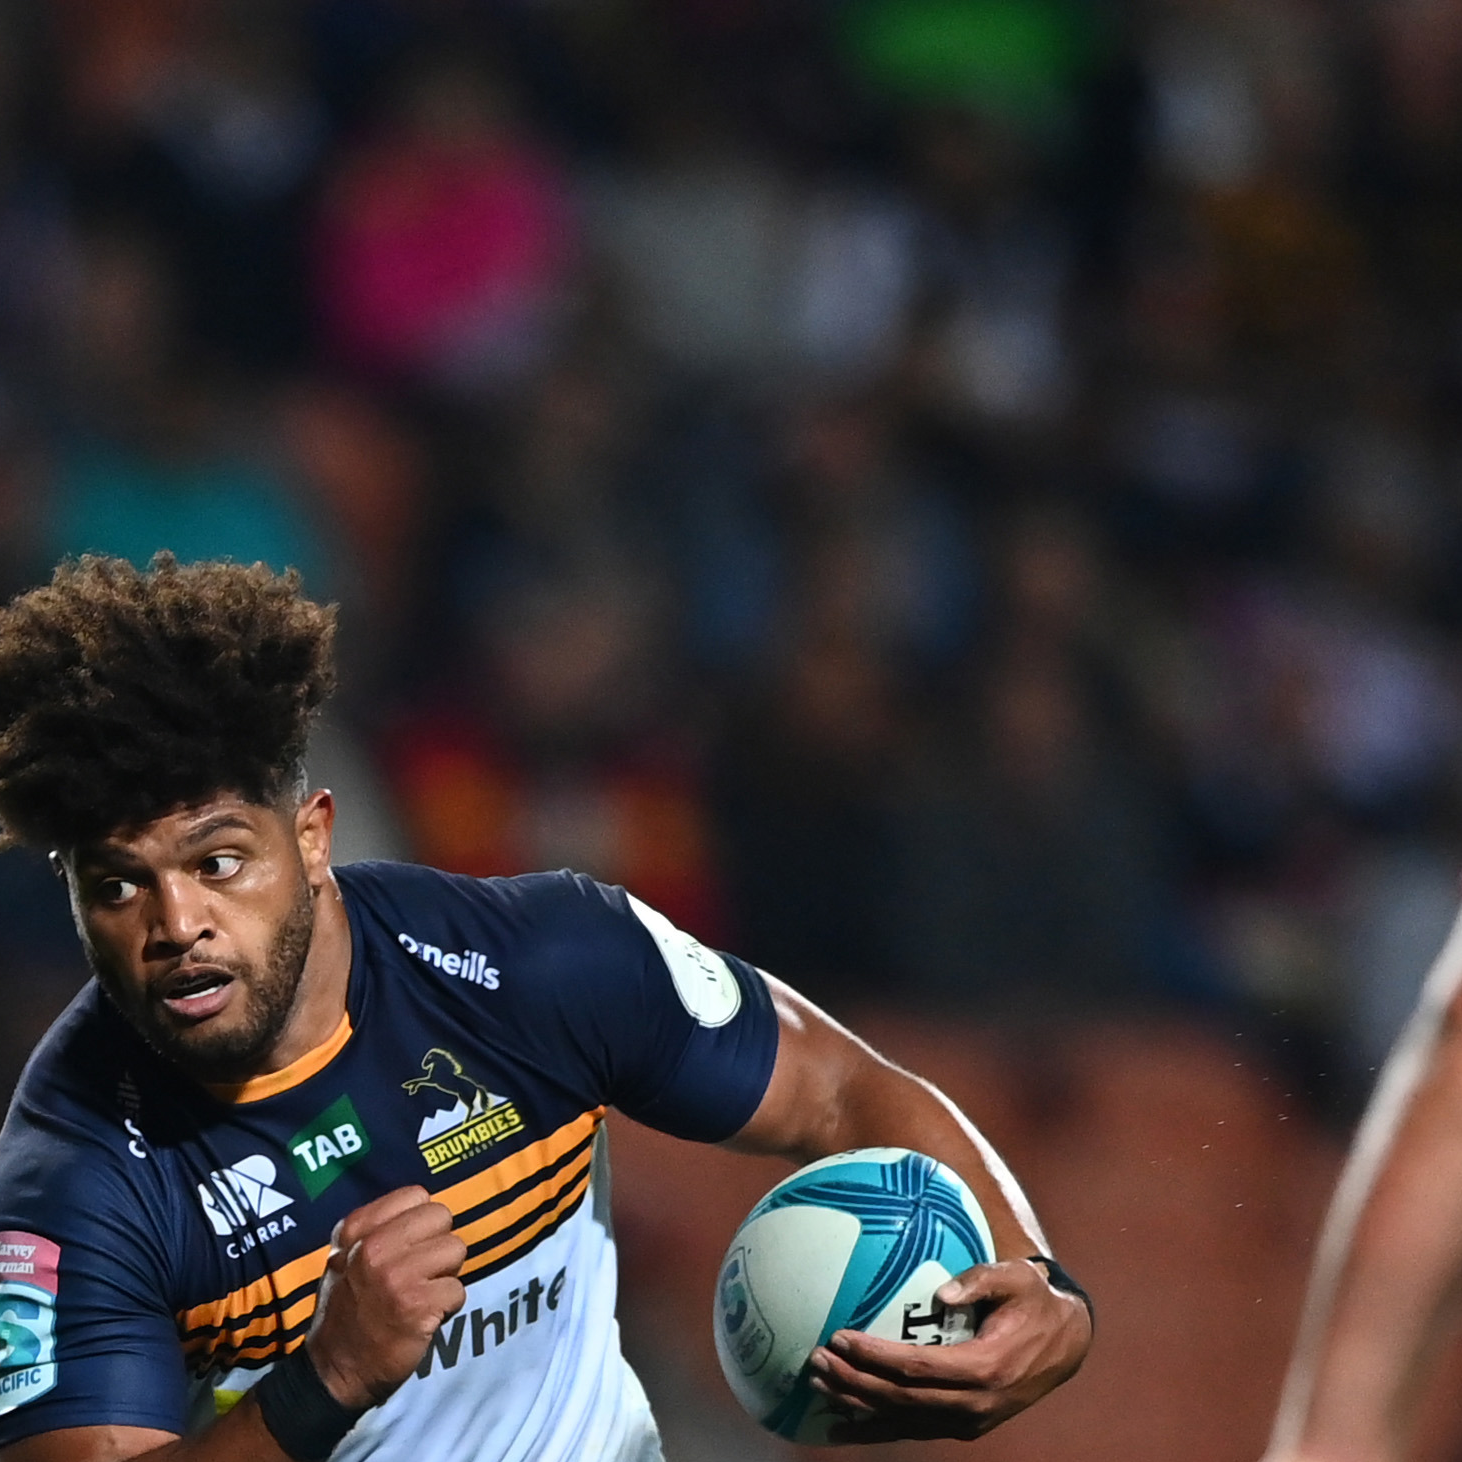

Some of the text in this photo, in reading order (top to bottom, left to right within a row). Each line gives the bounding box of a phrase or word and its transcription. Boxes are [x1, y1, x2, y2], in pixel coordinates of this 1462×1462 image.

[293, 1123, 362, 1172] TAB
[422, 1108, 521, 1168] BRUMBIES
[415, 1265, 567, 1380] White
